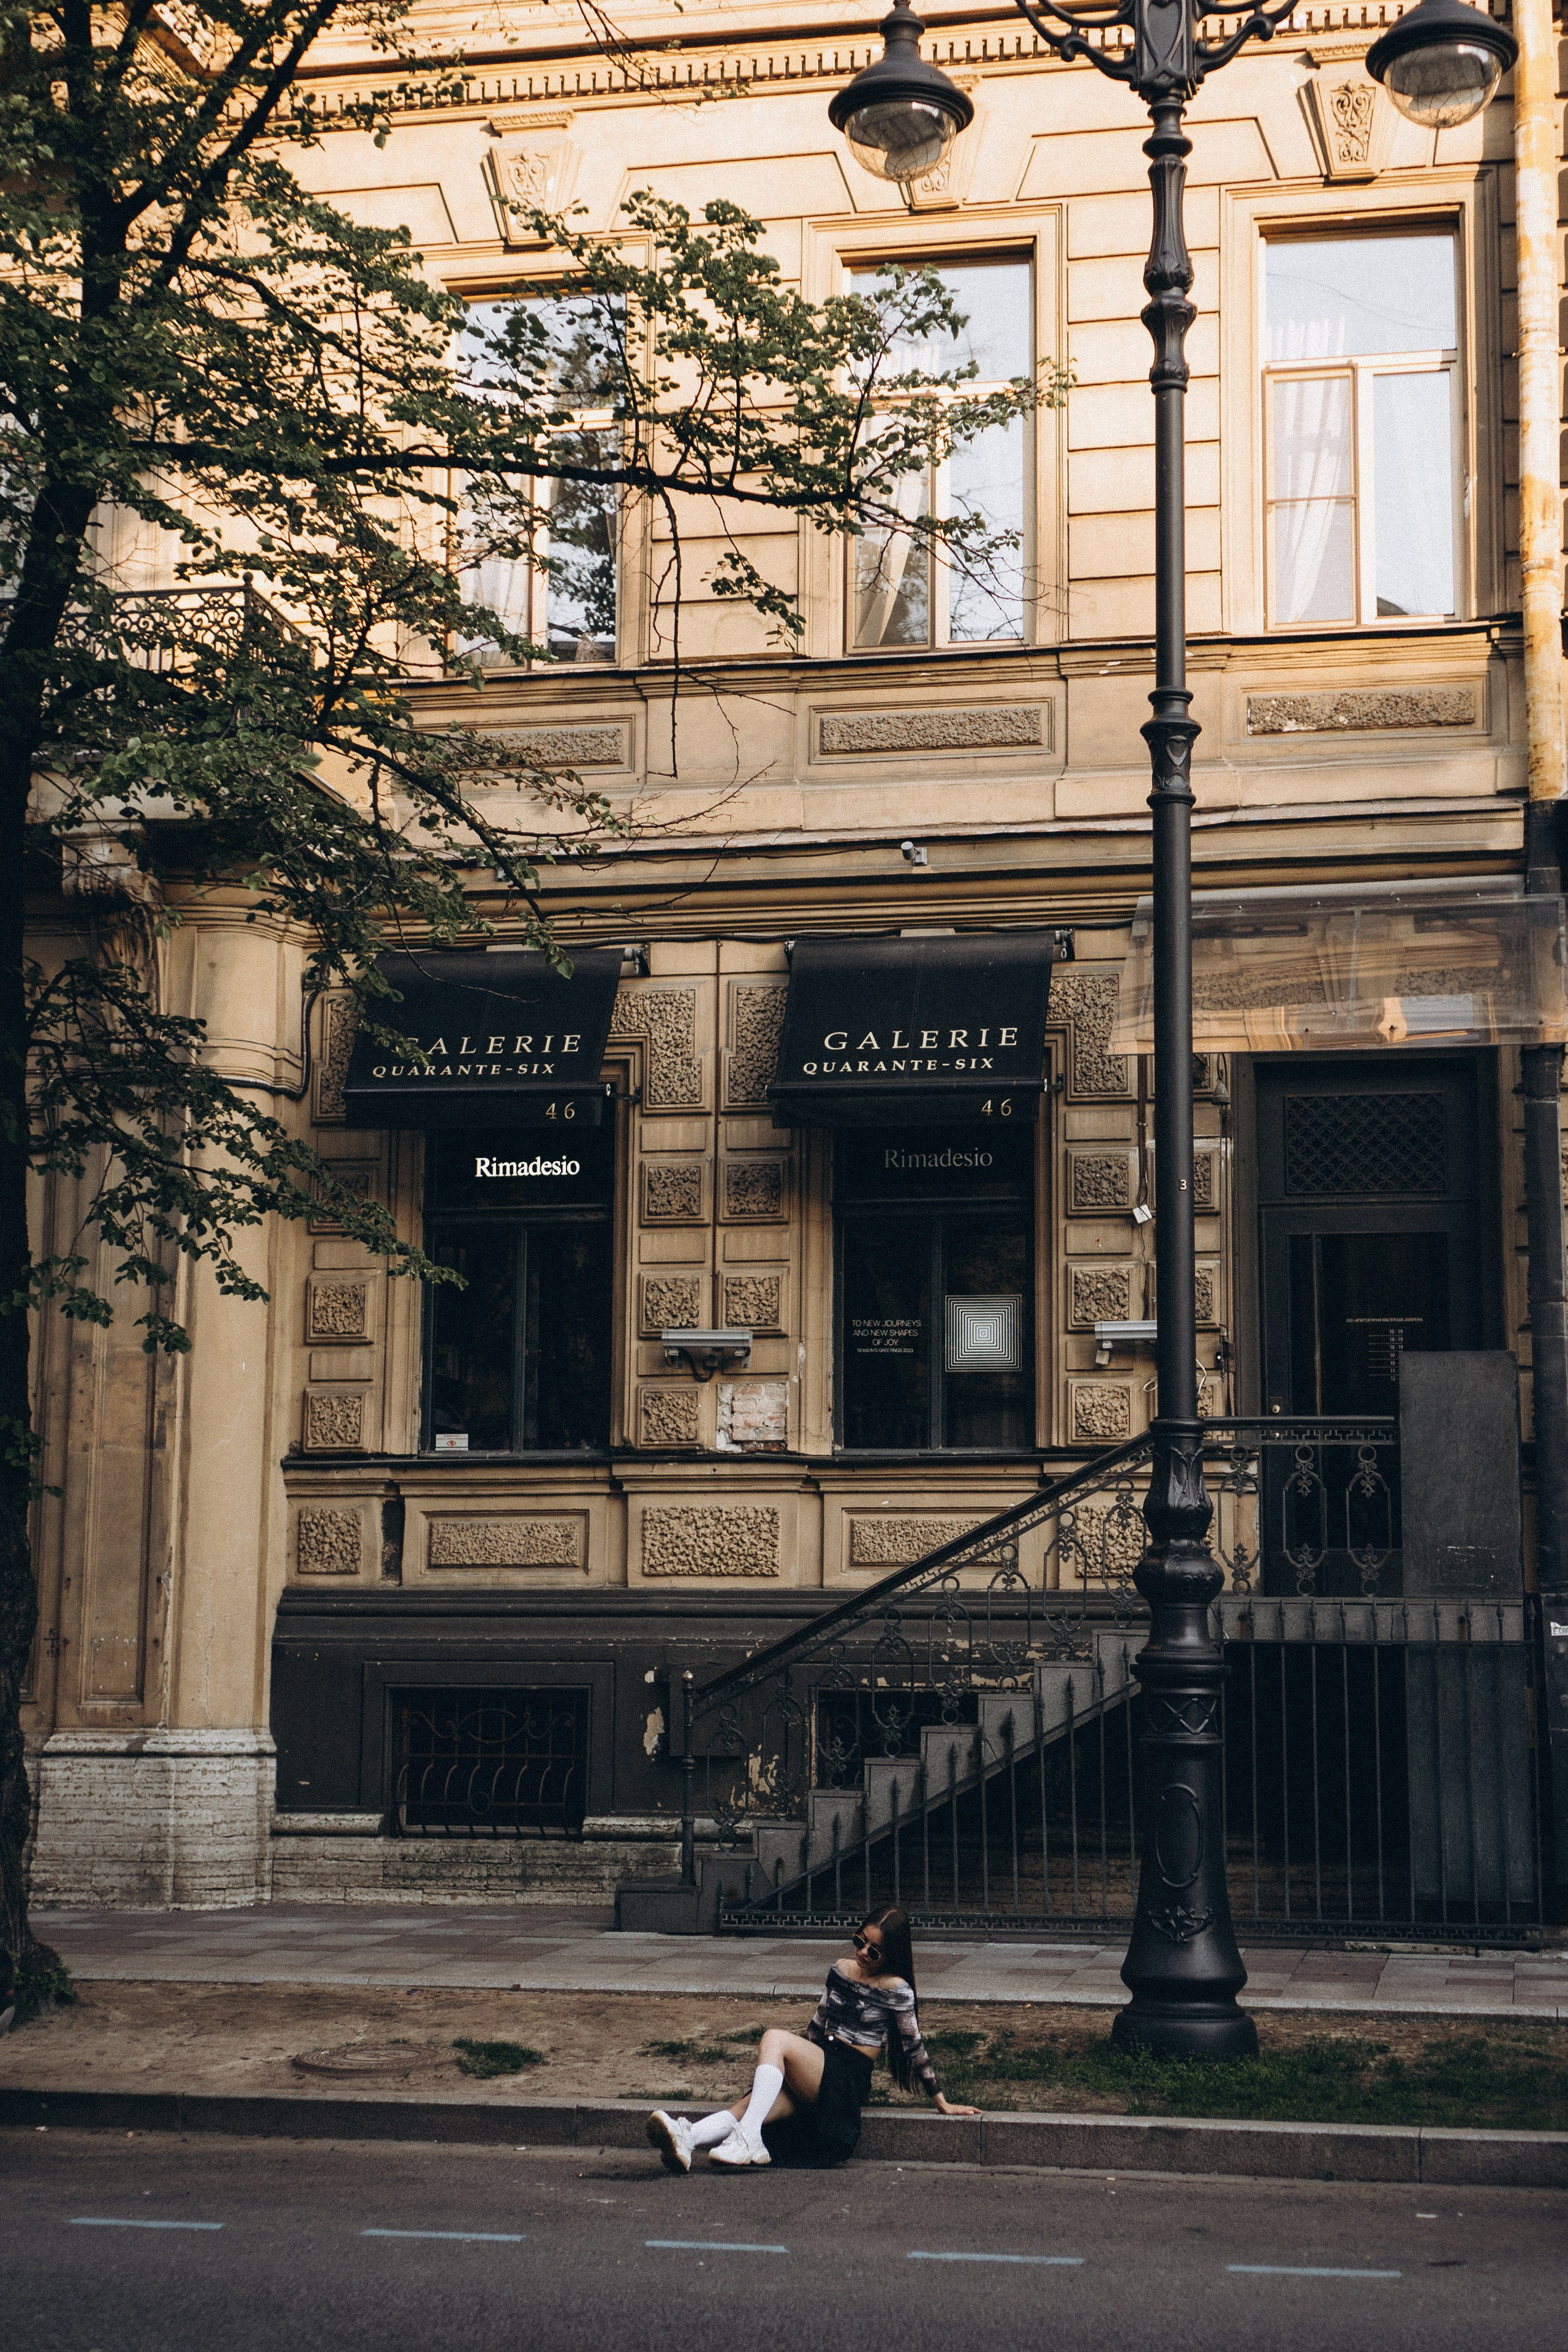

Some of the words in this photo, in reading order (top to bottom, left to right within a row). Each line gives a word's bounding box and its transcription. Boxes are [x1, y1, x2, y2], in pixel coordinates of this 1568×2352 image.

[398, 1034, 581, 1055] ALERIE
[824, 1027, 1018, 1050] GALERIE
[372, 1063, 555, 1078] QUARANTE-SIX
[803, 1058, 994, 1075] QUARANTE-SIX
[545, 1102, 575, 1119] 46
[981, 1098, 1012, 1116] 46
[475, 1155, 580, 1177] Rimadesio
[884, 1147, 993, 1167] Rimadesio
[1180, 1179, 1187, 1190] 3
